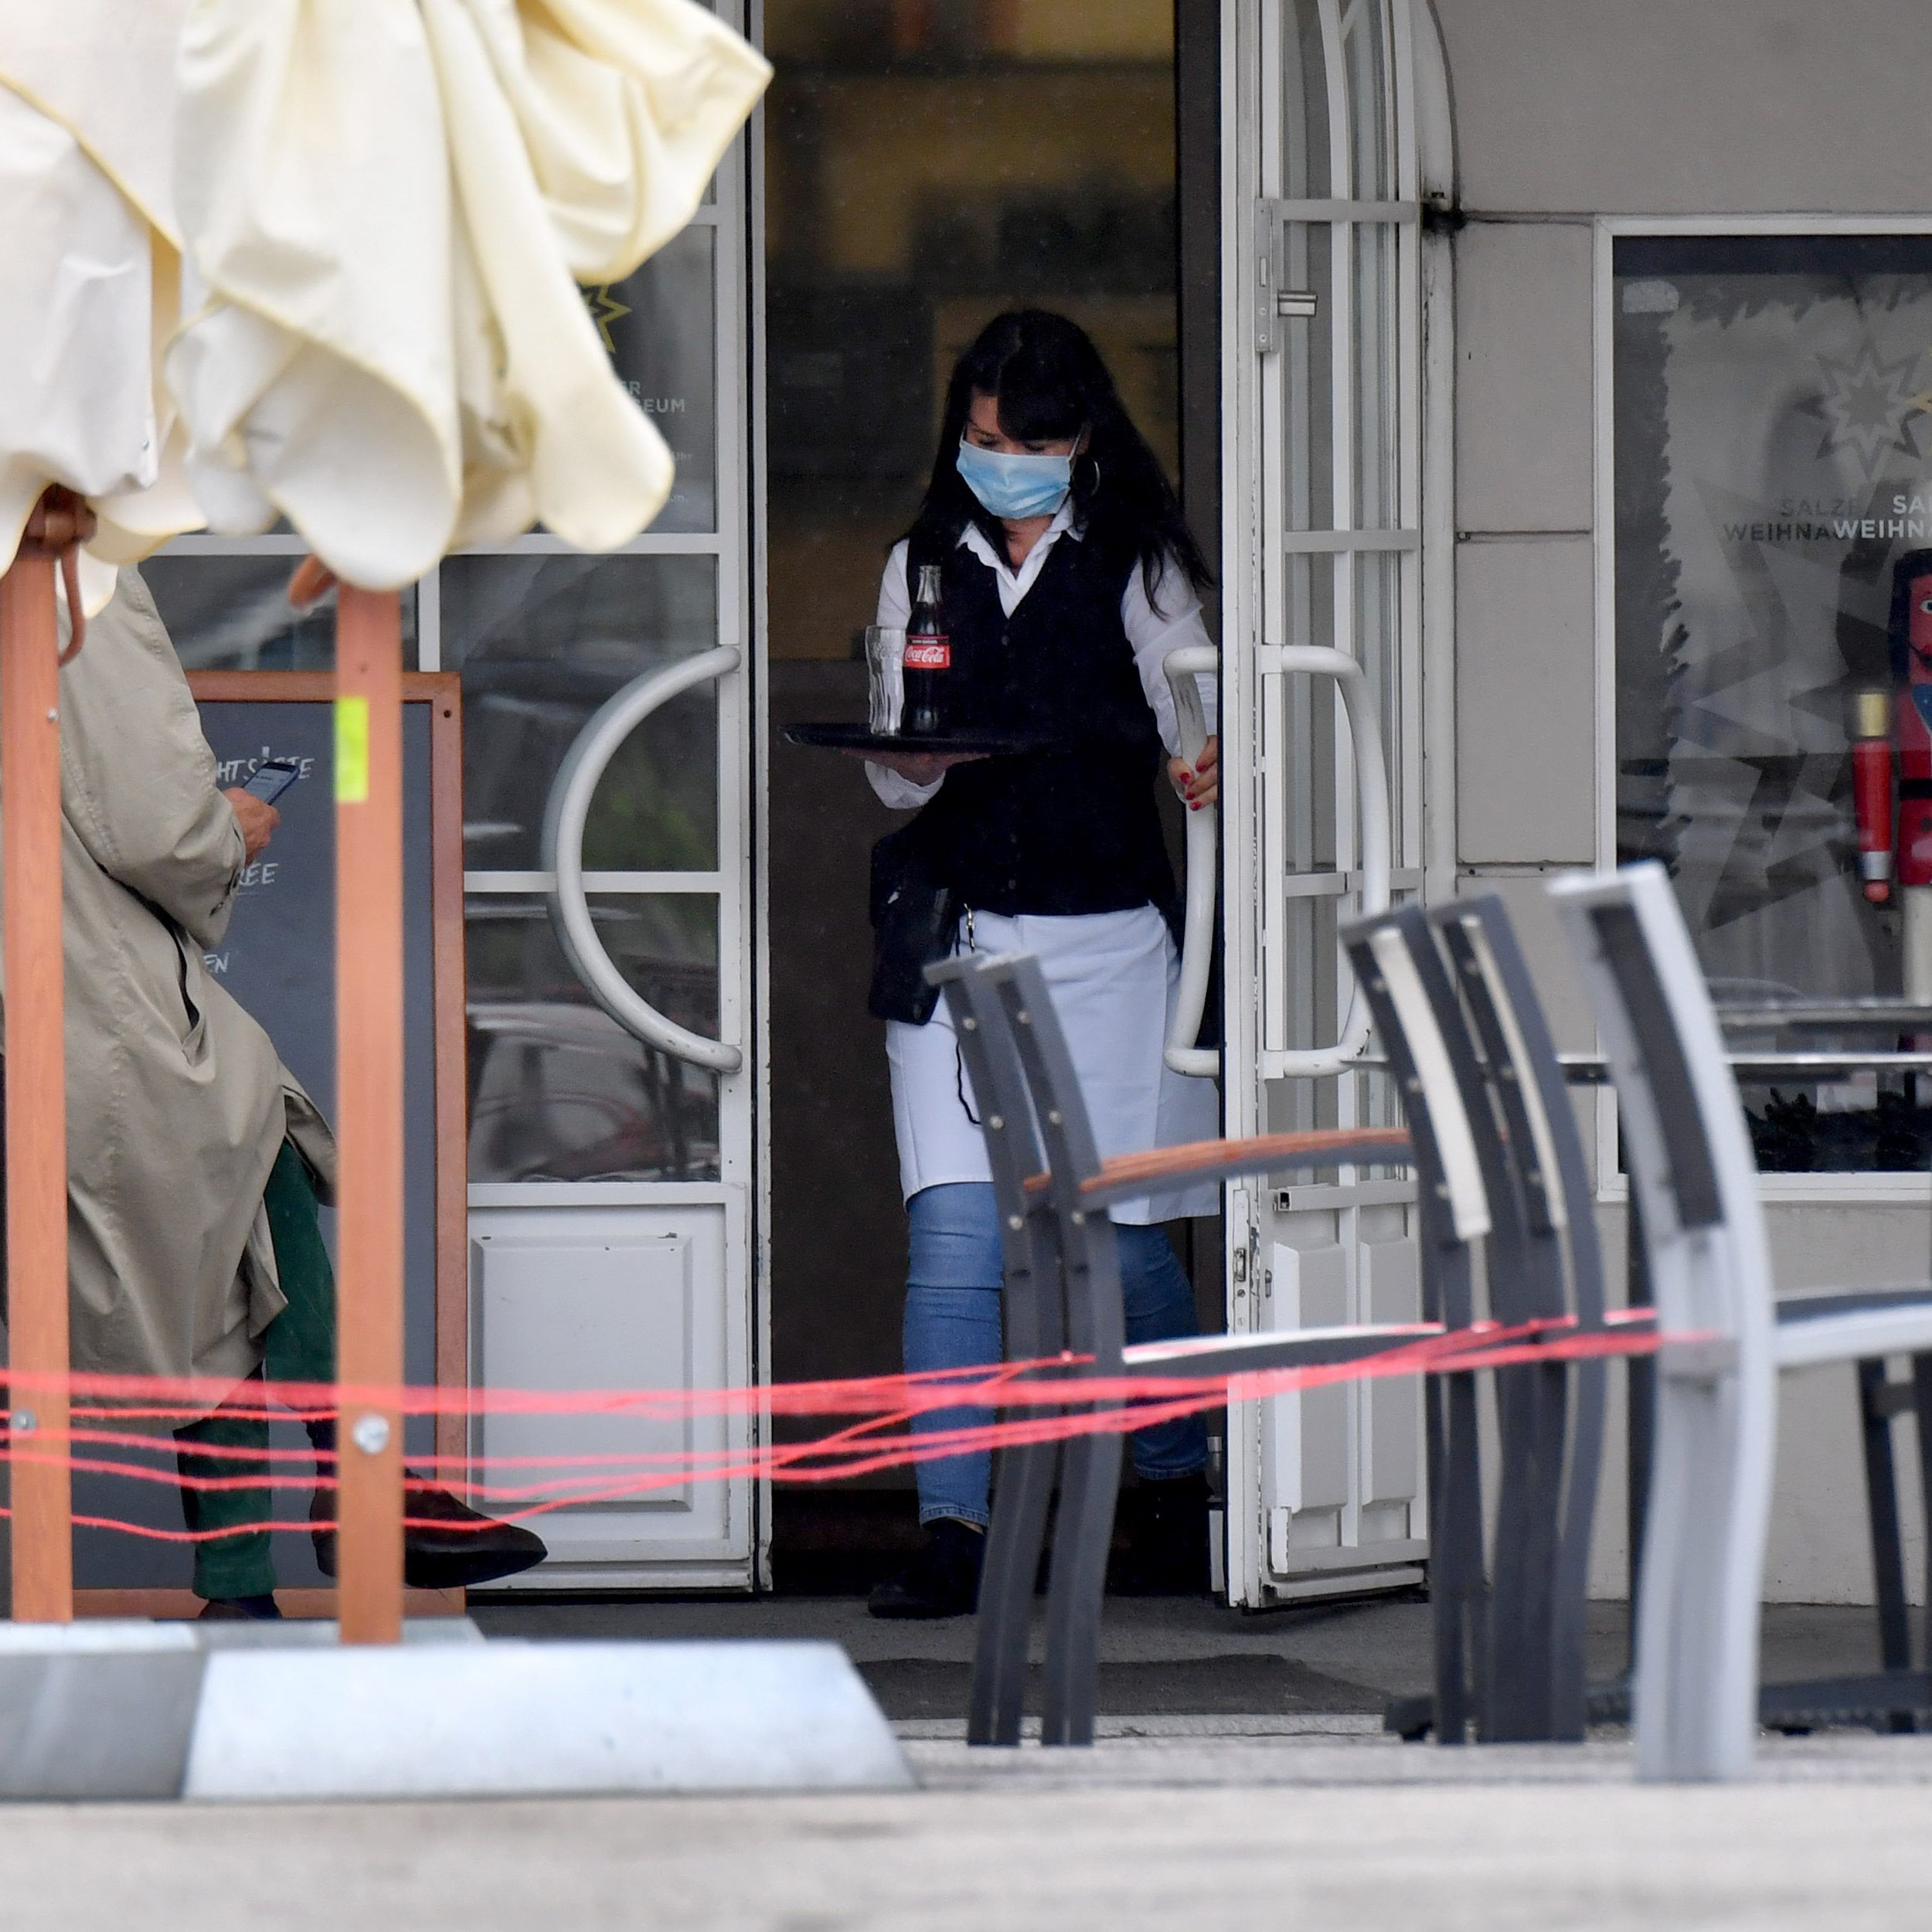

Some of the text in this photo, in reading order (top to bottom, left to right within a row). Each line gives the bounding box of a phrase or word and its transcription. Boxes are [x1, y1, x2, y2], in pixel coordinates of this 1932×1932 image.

[638, 398, 685, 413] EUM
[1893, 495, 1932, 515] SA
[905, 645, 944, 663] Coca-Cola
